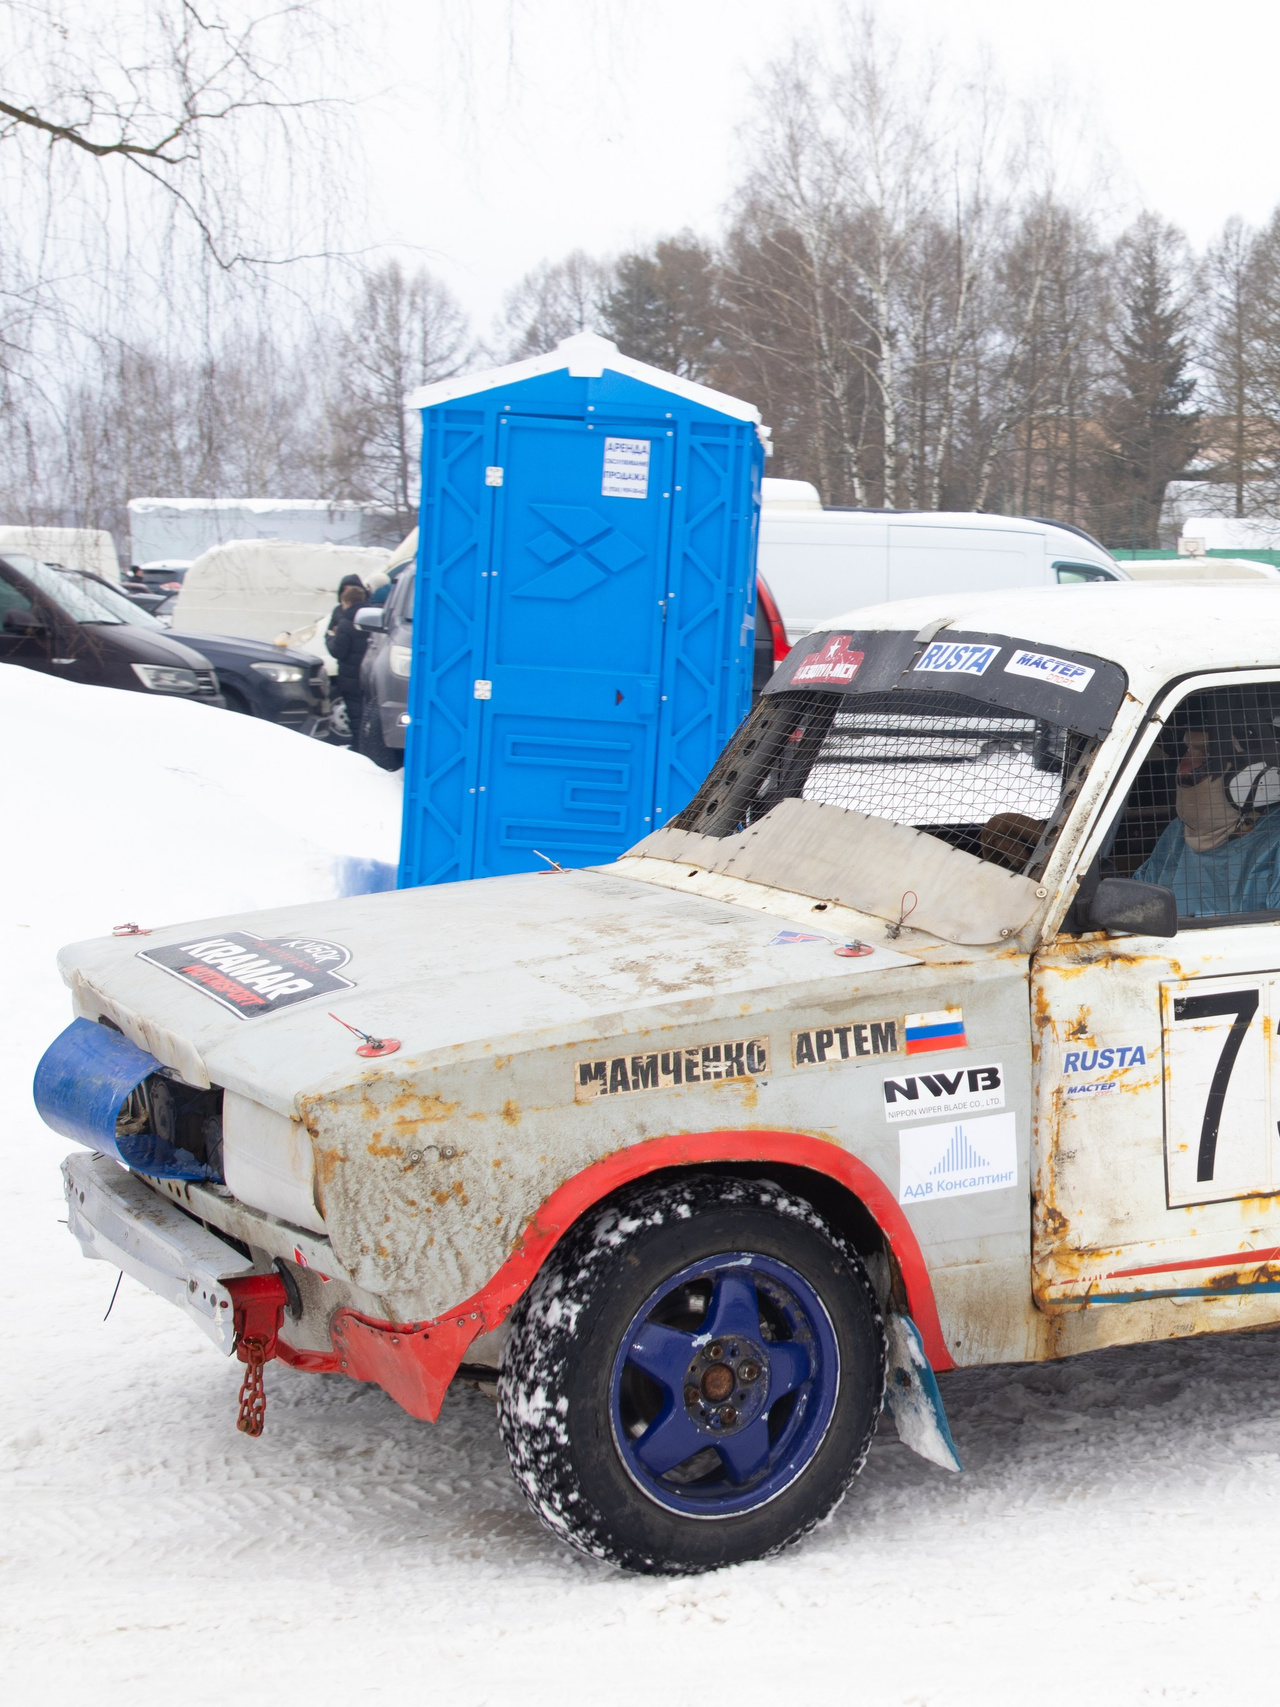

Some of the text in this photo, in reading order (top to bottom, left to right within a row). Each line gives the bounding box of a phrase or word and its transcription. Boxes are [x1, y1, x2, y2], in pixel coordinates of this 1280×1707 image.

[605, 442, 650, 455] АРЕНДА
[603, 470, 648, 482] ПРОДАЖА
[916, 644, 995, 673] RUSTA
[1015, 653, 1087, 678] МАСТЕР
[280, 939, 341, 964] КУБОК
[179, 938, 314, 1001] KRAMAR
[181, 964, 266, 1006] MOTORSPORT
[579, 1020, 898, 1096] МАМЧЕНКО АРТЕМ
[1063, 1045, 1146, 1074] RUSTA
[884, 1066, 1002, 1103] NWB
[1067, 1082, 1116, 1095] МАСТЕР
[888, 1108, 917, 1119] NIPPON
[918, 1105, 943, 1115] WIPER
[944, 1102, 968, 1112] BLADE
[986, 1097, 1002, 1106] LTD.
[904, 1170, 1015, 1199] АДВ Консалтинг
